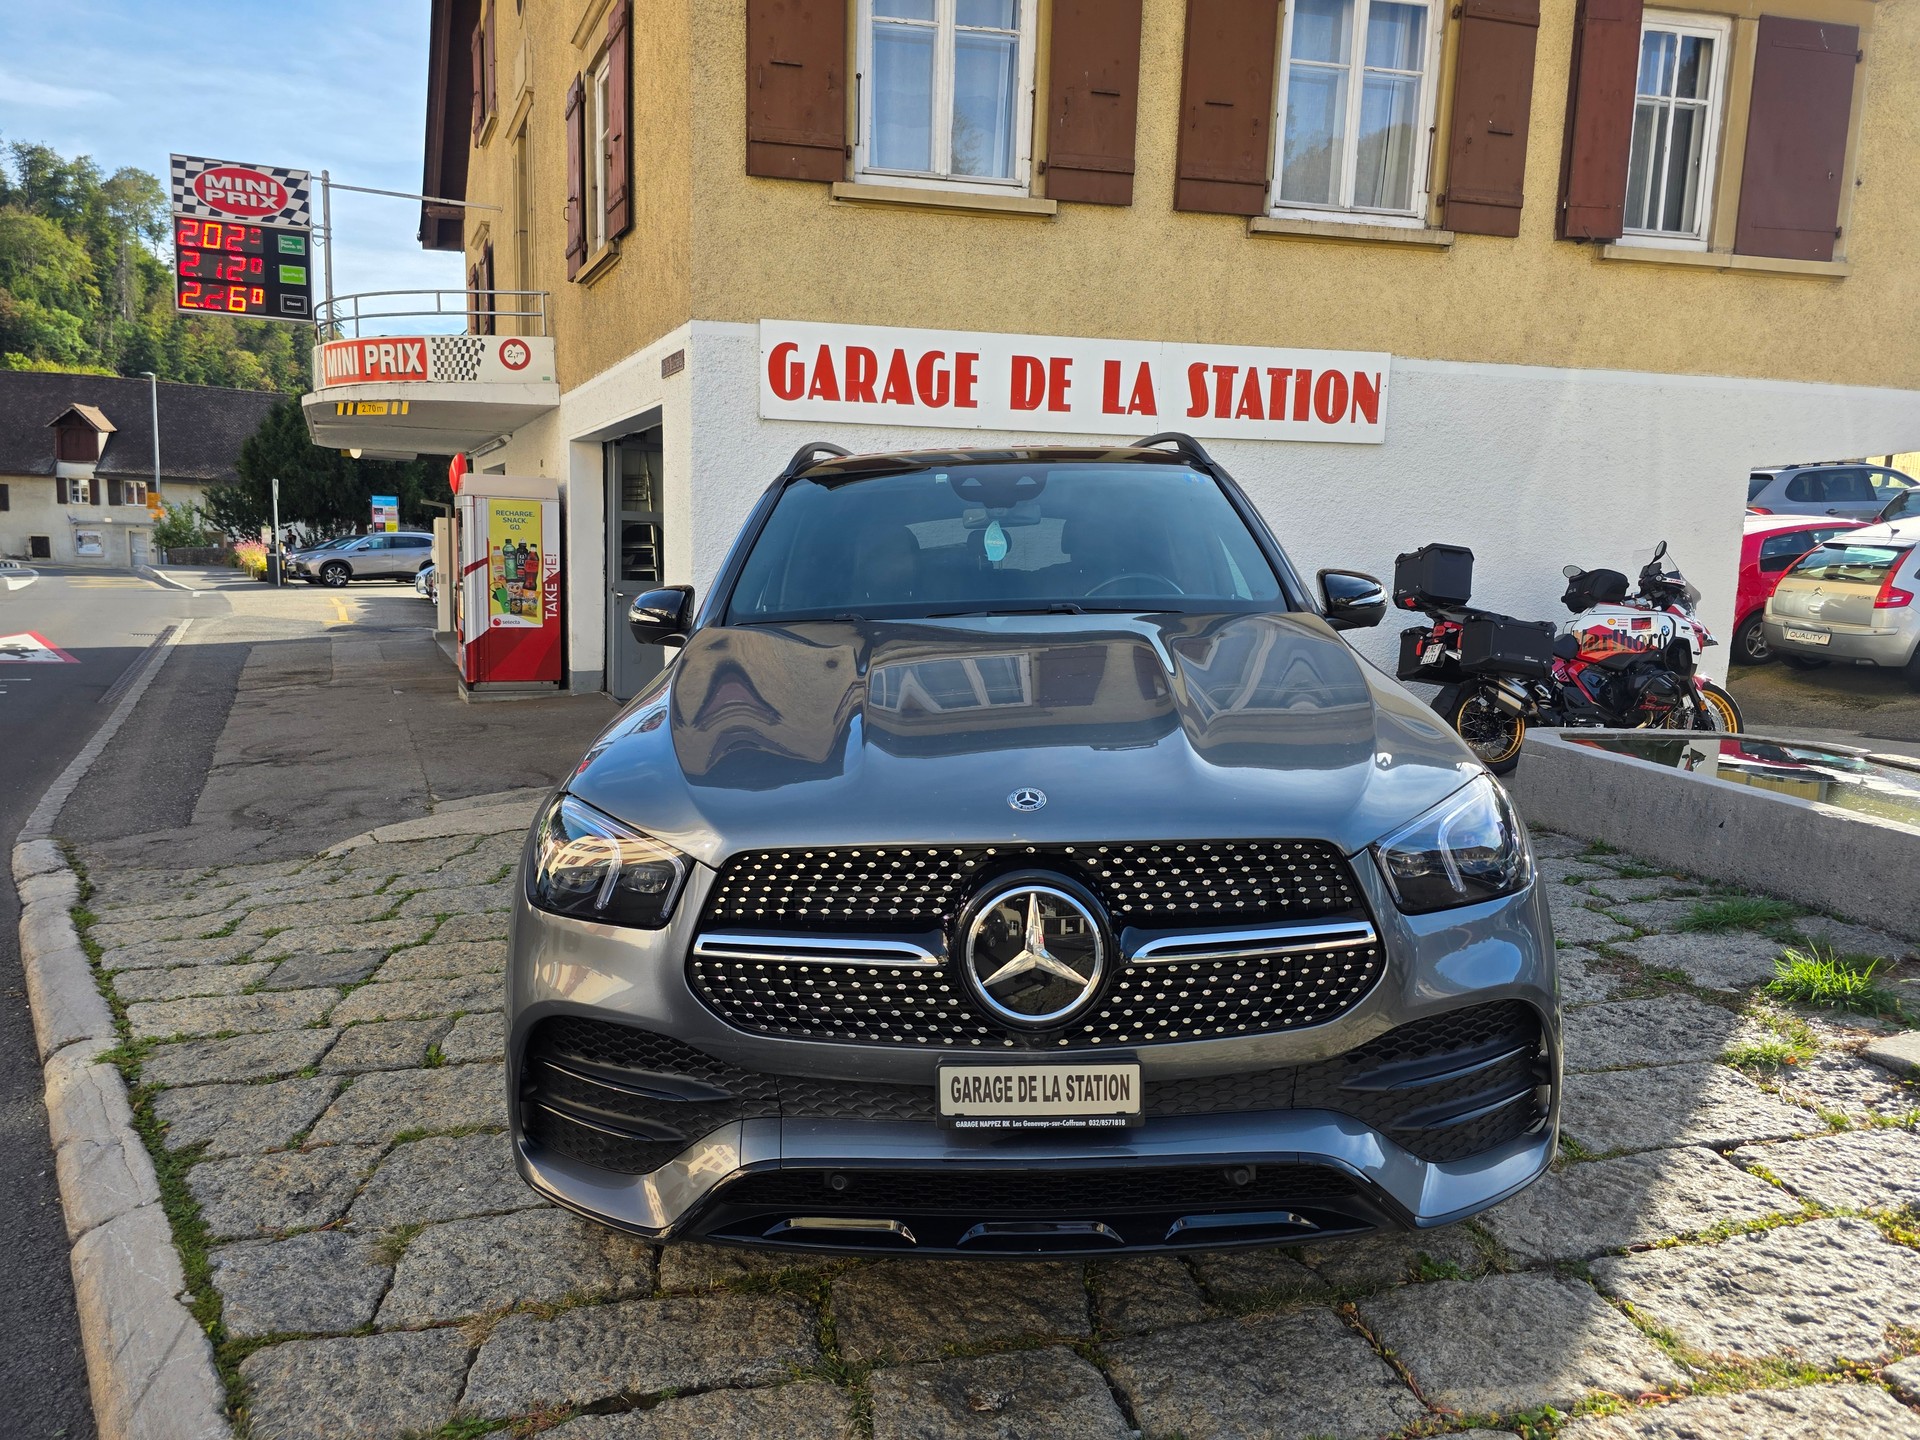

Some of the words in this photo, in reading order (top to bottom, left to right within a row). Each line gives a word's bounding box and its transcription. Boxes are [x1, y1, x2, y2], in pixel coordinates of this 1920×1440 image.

[205, 174, 278, 195] MINI
[205, 189, 279, 210] PRIX
[326, 346, 360, 378] MINI
[364, 343, 424, 375] PRIX
[768, 341, 979, 408] GARAGE
[1010, 355, 1073, 412] DE
[1102, 360, 1158, 416] LA
[1187, 362, 1382, 425] STATION
[495, 509, 535, 517] RECHARGE.
[544, 553, 557, 579] ME!
[545, 583, 558, 620] TAKE
[1789, 631, 1823, 641] QUALITY
[951, 1075, 1013, 1103] GARAGE
[1018, 1075, 1037, 1102] DE
[1042, 1075, 1062, 1102] LA
[1065, 1074, 1130, 1102] STATION
[955, 1120, 979, 1128] GARAGE
[979, 1120, 1002, 1128] NAPPEZ
[1022, 1119, 1087, 1128] Geneveys-sur-Coffrane
[1088, 1119, 1126, 1127] 032/8571818
